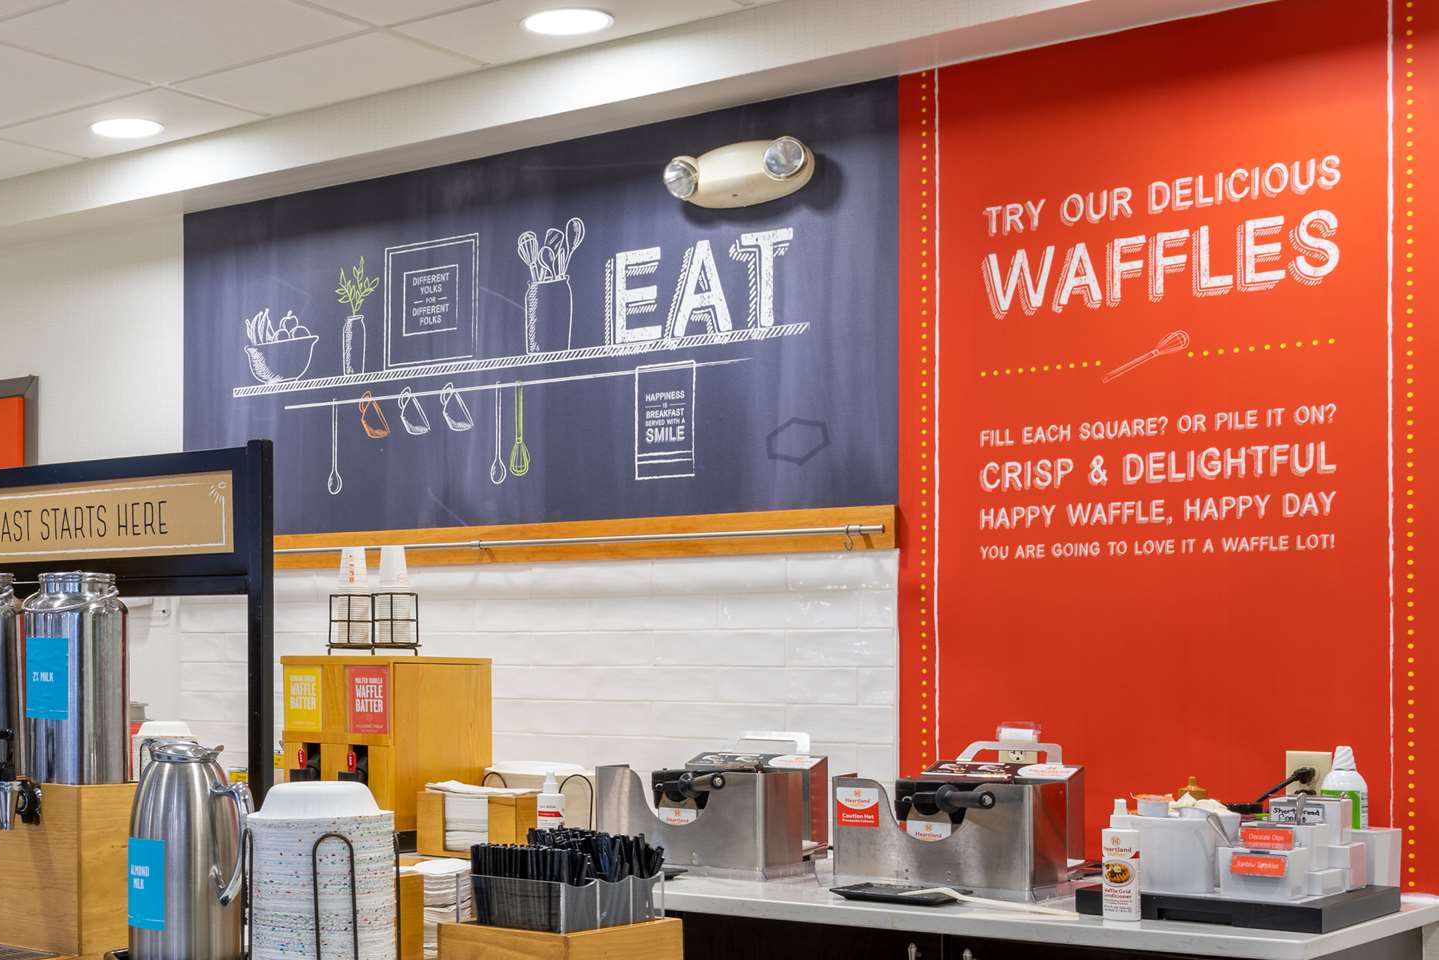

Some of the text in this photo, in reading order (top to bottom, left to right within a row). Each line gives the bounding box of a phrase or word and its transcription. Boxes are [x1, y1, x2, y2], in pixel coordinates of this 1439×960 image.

[983, 154, 1342, 237] TRY OUR DELICIOUS
[981, 209, 1341, 320] WAFFLES
[412, 272, 449, 286] DIFFERENT
[604, 227, 794, 346] EAT
[420, 284, 442, 294] YOLKS
[412, 303, 449, 317] DIFFERENT
[420, 314, 442, 326] FOLKS
[645, 390, 685, 401] HAPPINESS
[645, 408, 684, 419] BREAKFAST
[666, 417, 680, 425] WITH
[979, 403, 1337, 448] FILL EACH SQUARE? OR PILE IT ON?
[645, 425, 686, 443] SMILE
[980, 440, 1337, 492] CRISP & DELIGHTFUL
[979, 490, 1337, 530] HAPPY WAFFLE, HAPPY DAY
[40, 504, 107, 541] STARTS
[116, 500, 169, 537] HERE
[979, 533, 1336, 561] YOU ARE GOING TO LOVE IT A WAFFLE LOT!
[40, 671, 54, 683] MILK
[355, 684, 383, 699] WAFFLE
[355, 699, 383, 713] BATTER
